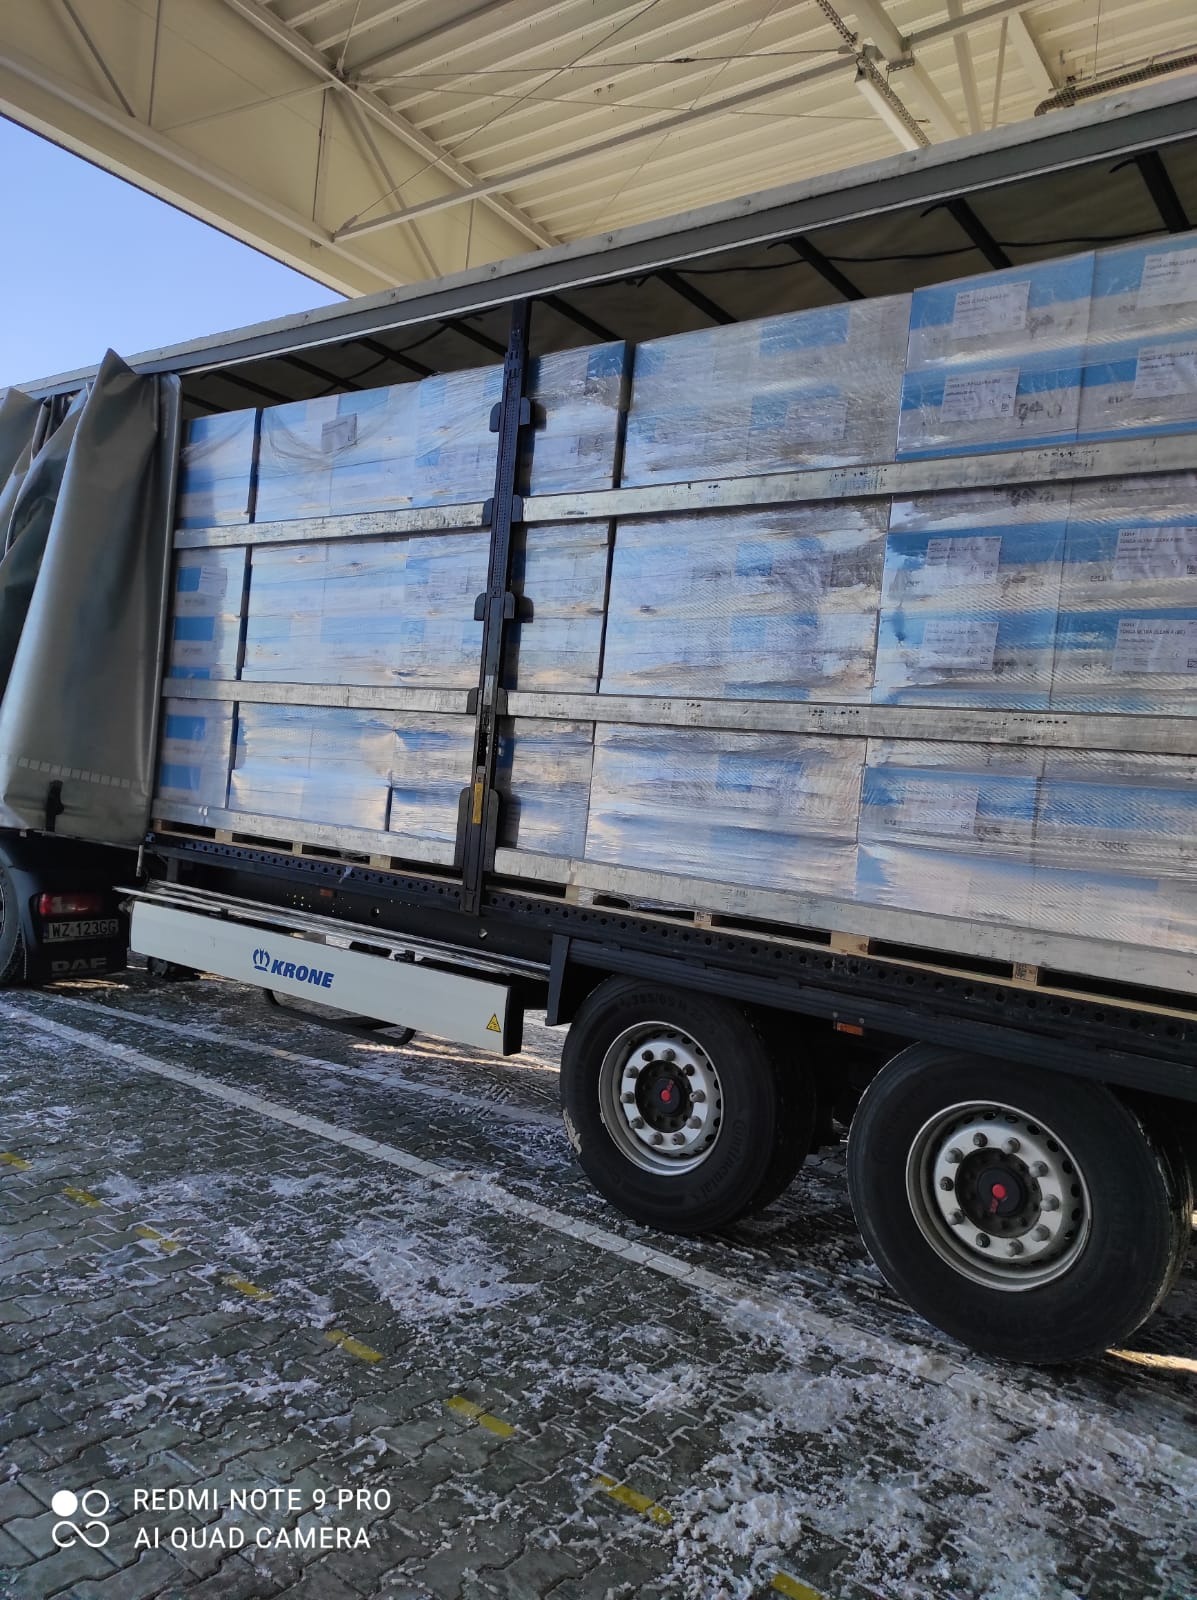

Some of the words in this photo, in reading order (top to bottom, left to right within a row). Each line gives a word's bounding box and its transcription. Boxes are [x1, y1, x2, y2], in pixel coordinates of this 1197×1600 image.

[52, 923, 70, 937] WZ
[51, 957, 107, 971] DAF
[271, 959, 335, 988] KRONE
